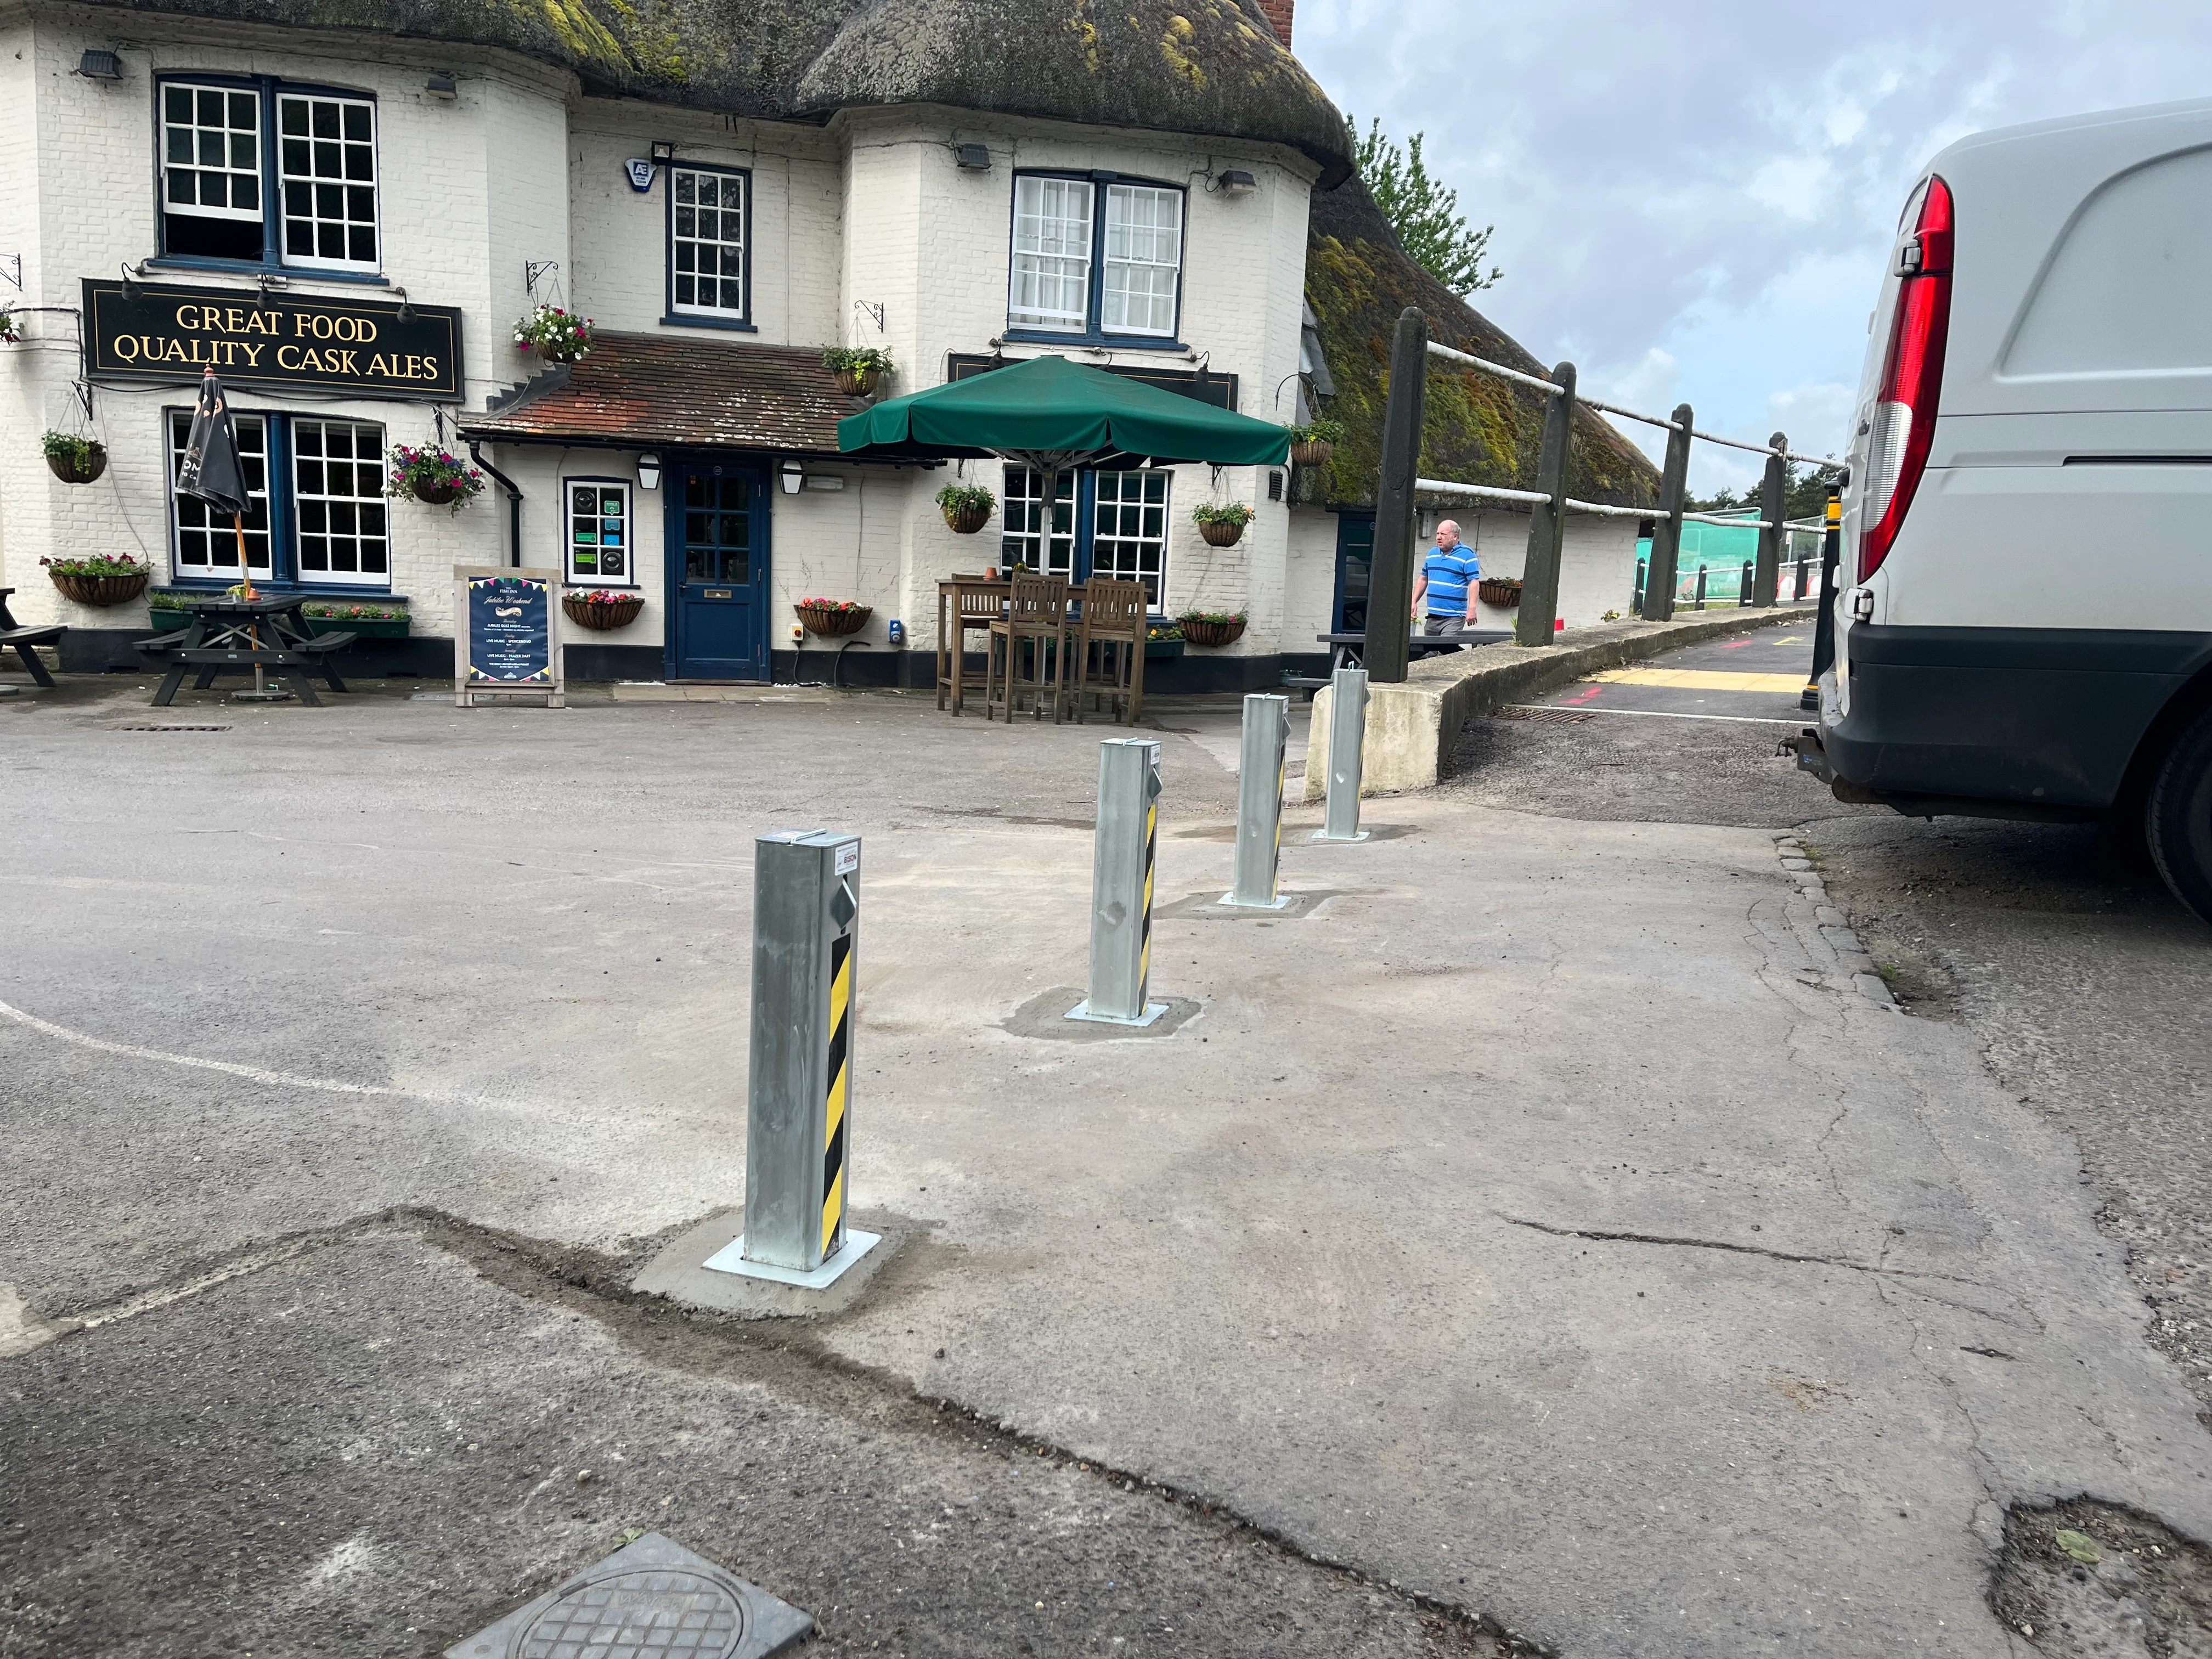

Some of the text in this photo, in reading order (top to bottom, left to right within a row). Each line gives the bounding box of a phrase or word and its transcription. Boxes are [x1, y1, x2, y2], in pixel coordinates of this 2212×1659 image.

[176, 305, 377, 343] GREAT FOOD
[114, 335, 438, 380] QUALITY CASK ALES
[505, 595, 533, 604] Weekend
